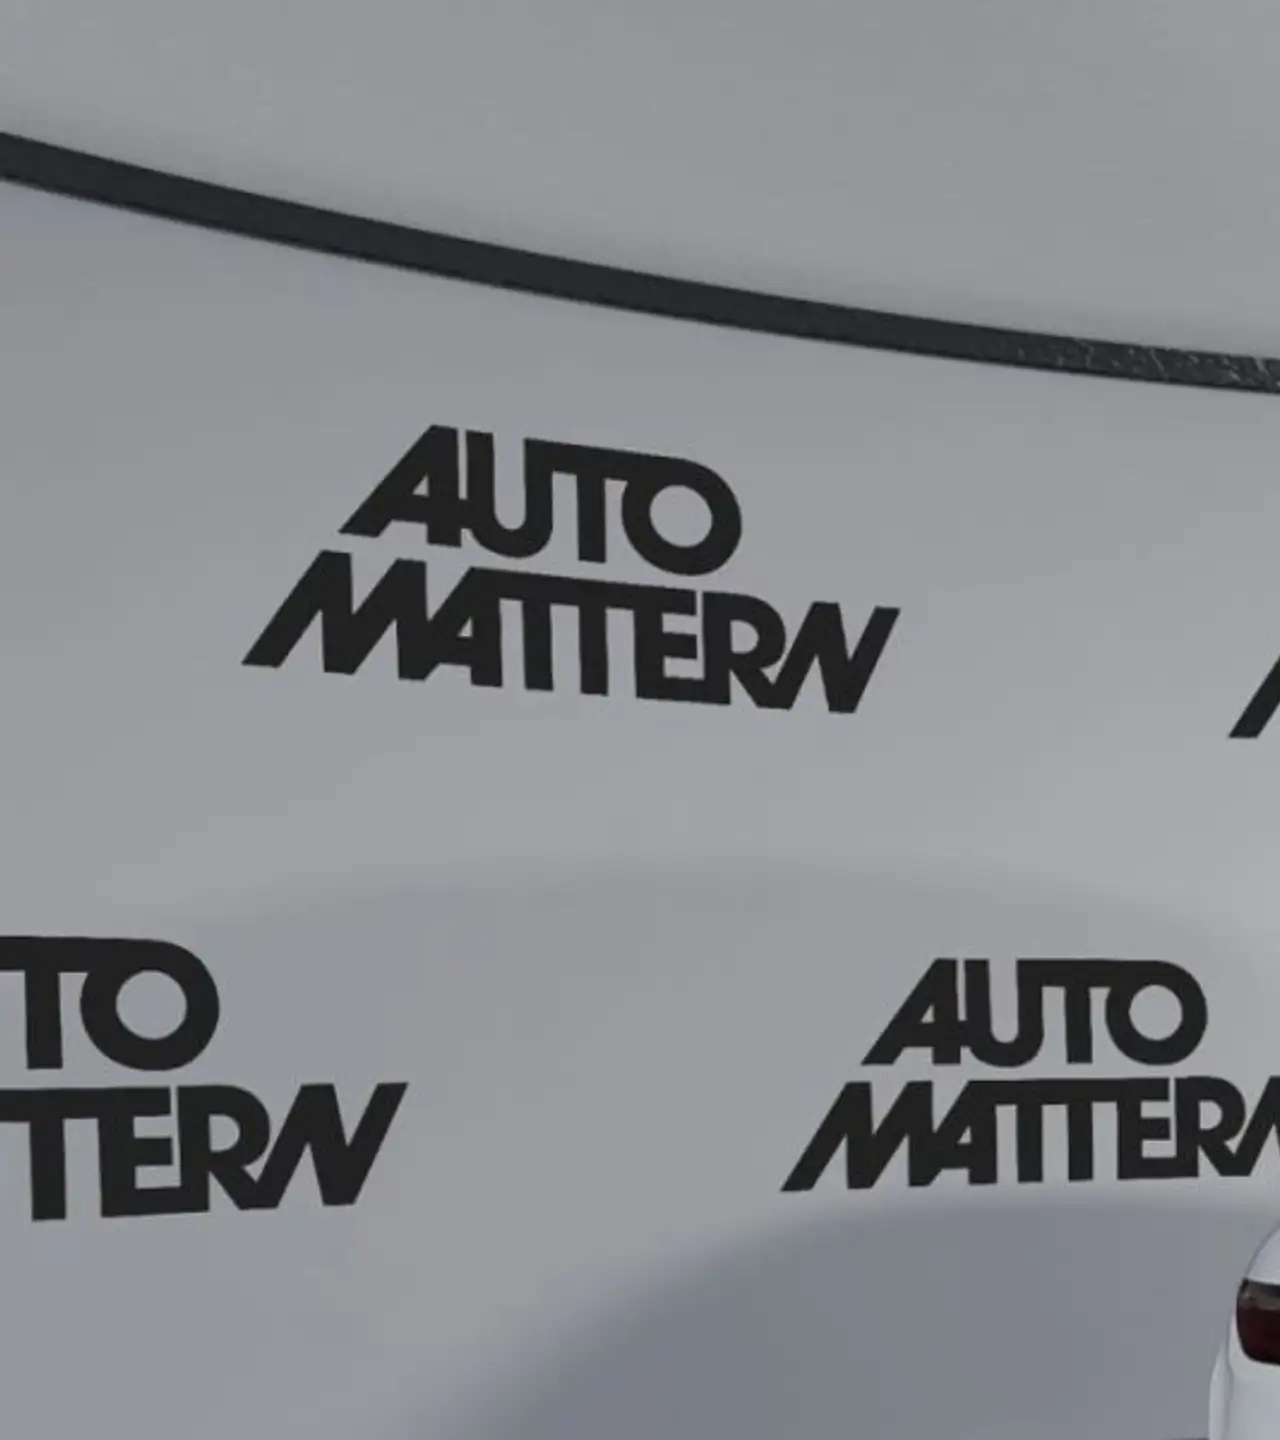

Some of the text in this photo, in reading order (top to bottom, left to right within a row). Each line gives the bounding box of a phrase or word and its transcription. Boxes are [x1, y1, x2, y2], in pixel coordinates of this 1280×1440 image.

[339, 425, 741, 576] AUTO
[242, 550, 899, 713] MATTERN
[862, 958, 1207, 1067] AUTO
